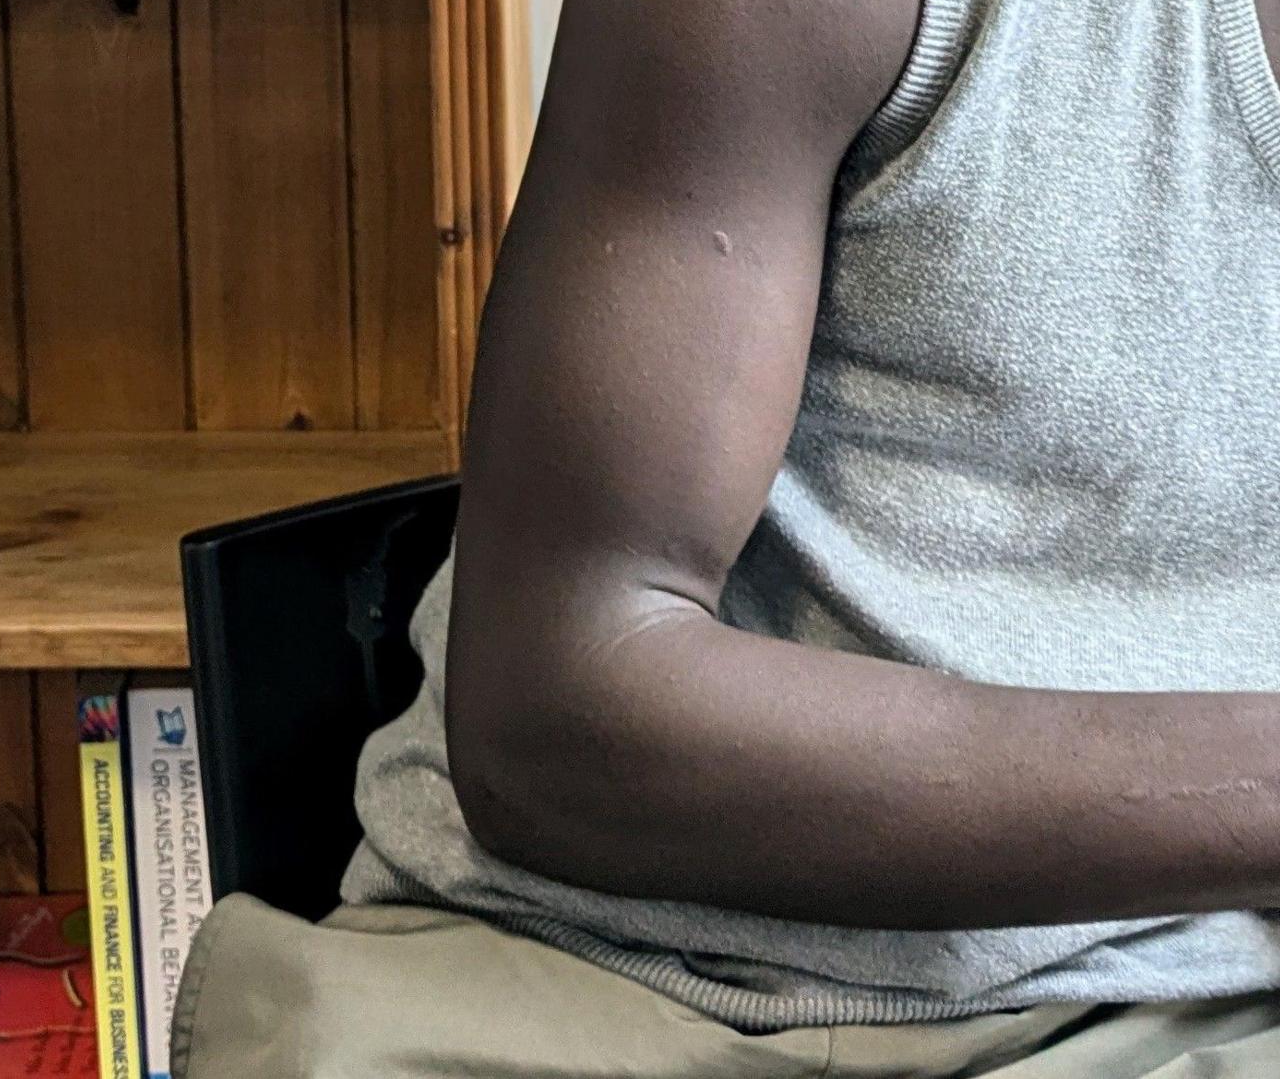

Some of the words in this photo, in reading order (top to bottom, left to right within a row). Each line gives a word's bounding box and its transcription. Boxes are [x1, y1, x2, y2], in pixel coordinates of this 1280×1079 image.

[93, 757, 117, 864] ACCOUNTING
[151, 758, 179, 940] ORGANISATIONAL
[177, 758, 204, 906] MANAGEMENT
[99, 866, 119, 899] AND
[102, 904, 123, 974] FINANCE
[106, 976, 125, 1004] FOR
